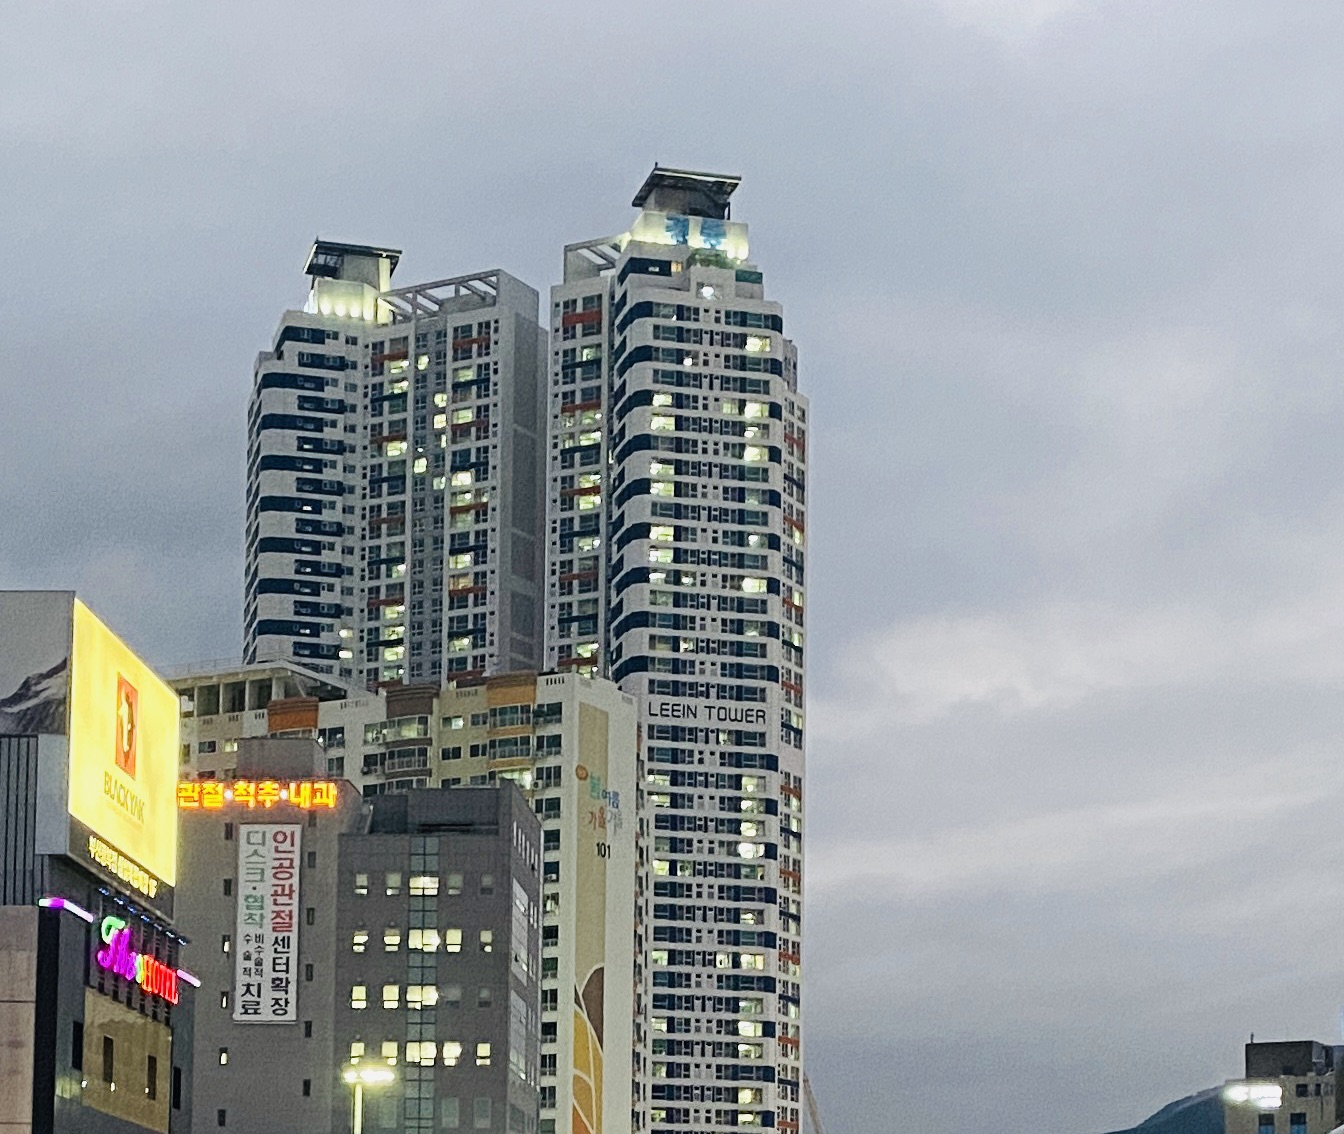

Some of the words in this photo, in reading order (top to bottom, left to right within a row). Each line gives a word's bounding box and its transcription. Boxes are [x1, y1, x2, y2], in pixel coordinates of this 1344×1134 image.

[648, 701, 698, 719] LEEIN
[704, 705, 766, 724] TOWER
[596, 842, 611, 859] 101
[270, 829, 295, 933] 인공관절
[240, 982, 262, 1016] 치료
